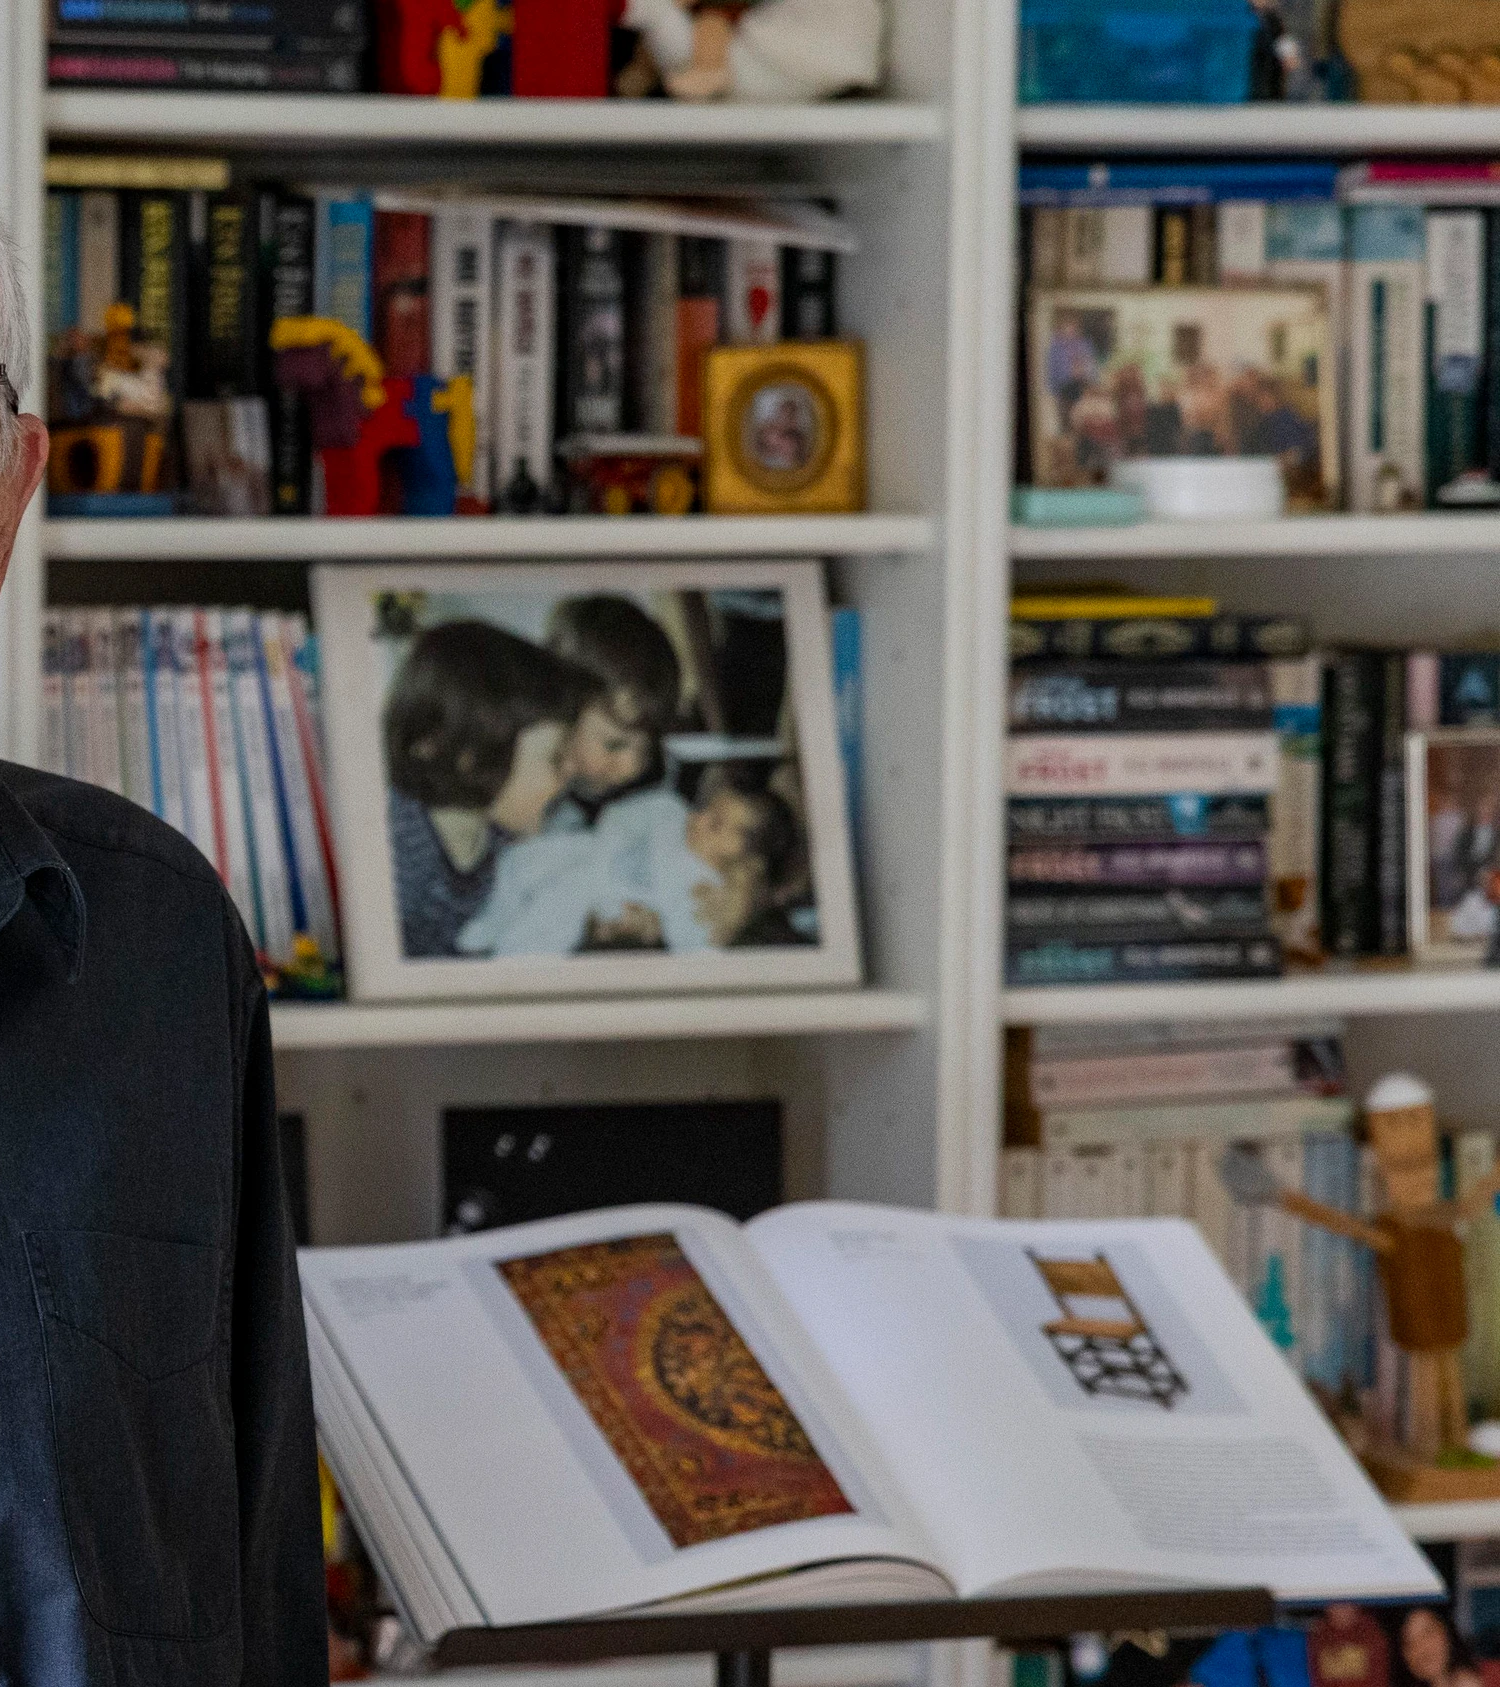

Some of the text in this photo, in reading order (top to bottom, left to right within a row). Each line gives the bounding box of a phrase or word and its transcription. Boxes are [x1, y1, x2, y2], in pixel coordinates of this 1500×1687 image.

[214, 208, 243, 257] KEN
[455, 297, 479, 375] HAYDE
[1016, 691, 1118, 720] FROST
[1017, 760, 1109, 784] FROST
[1009, 806, 1168, 833] NIGHT FROST
[1011, 855, 1100, 879] FROST
[1022, 951, 1114, 974] FROST
